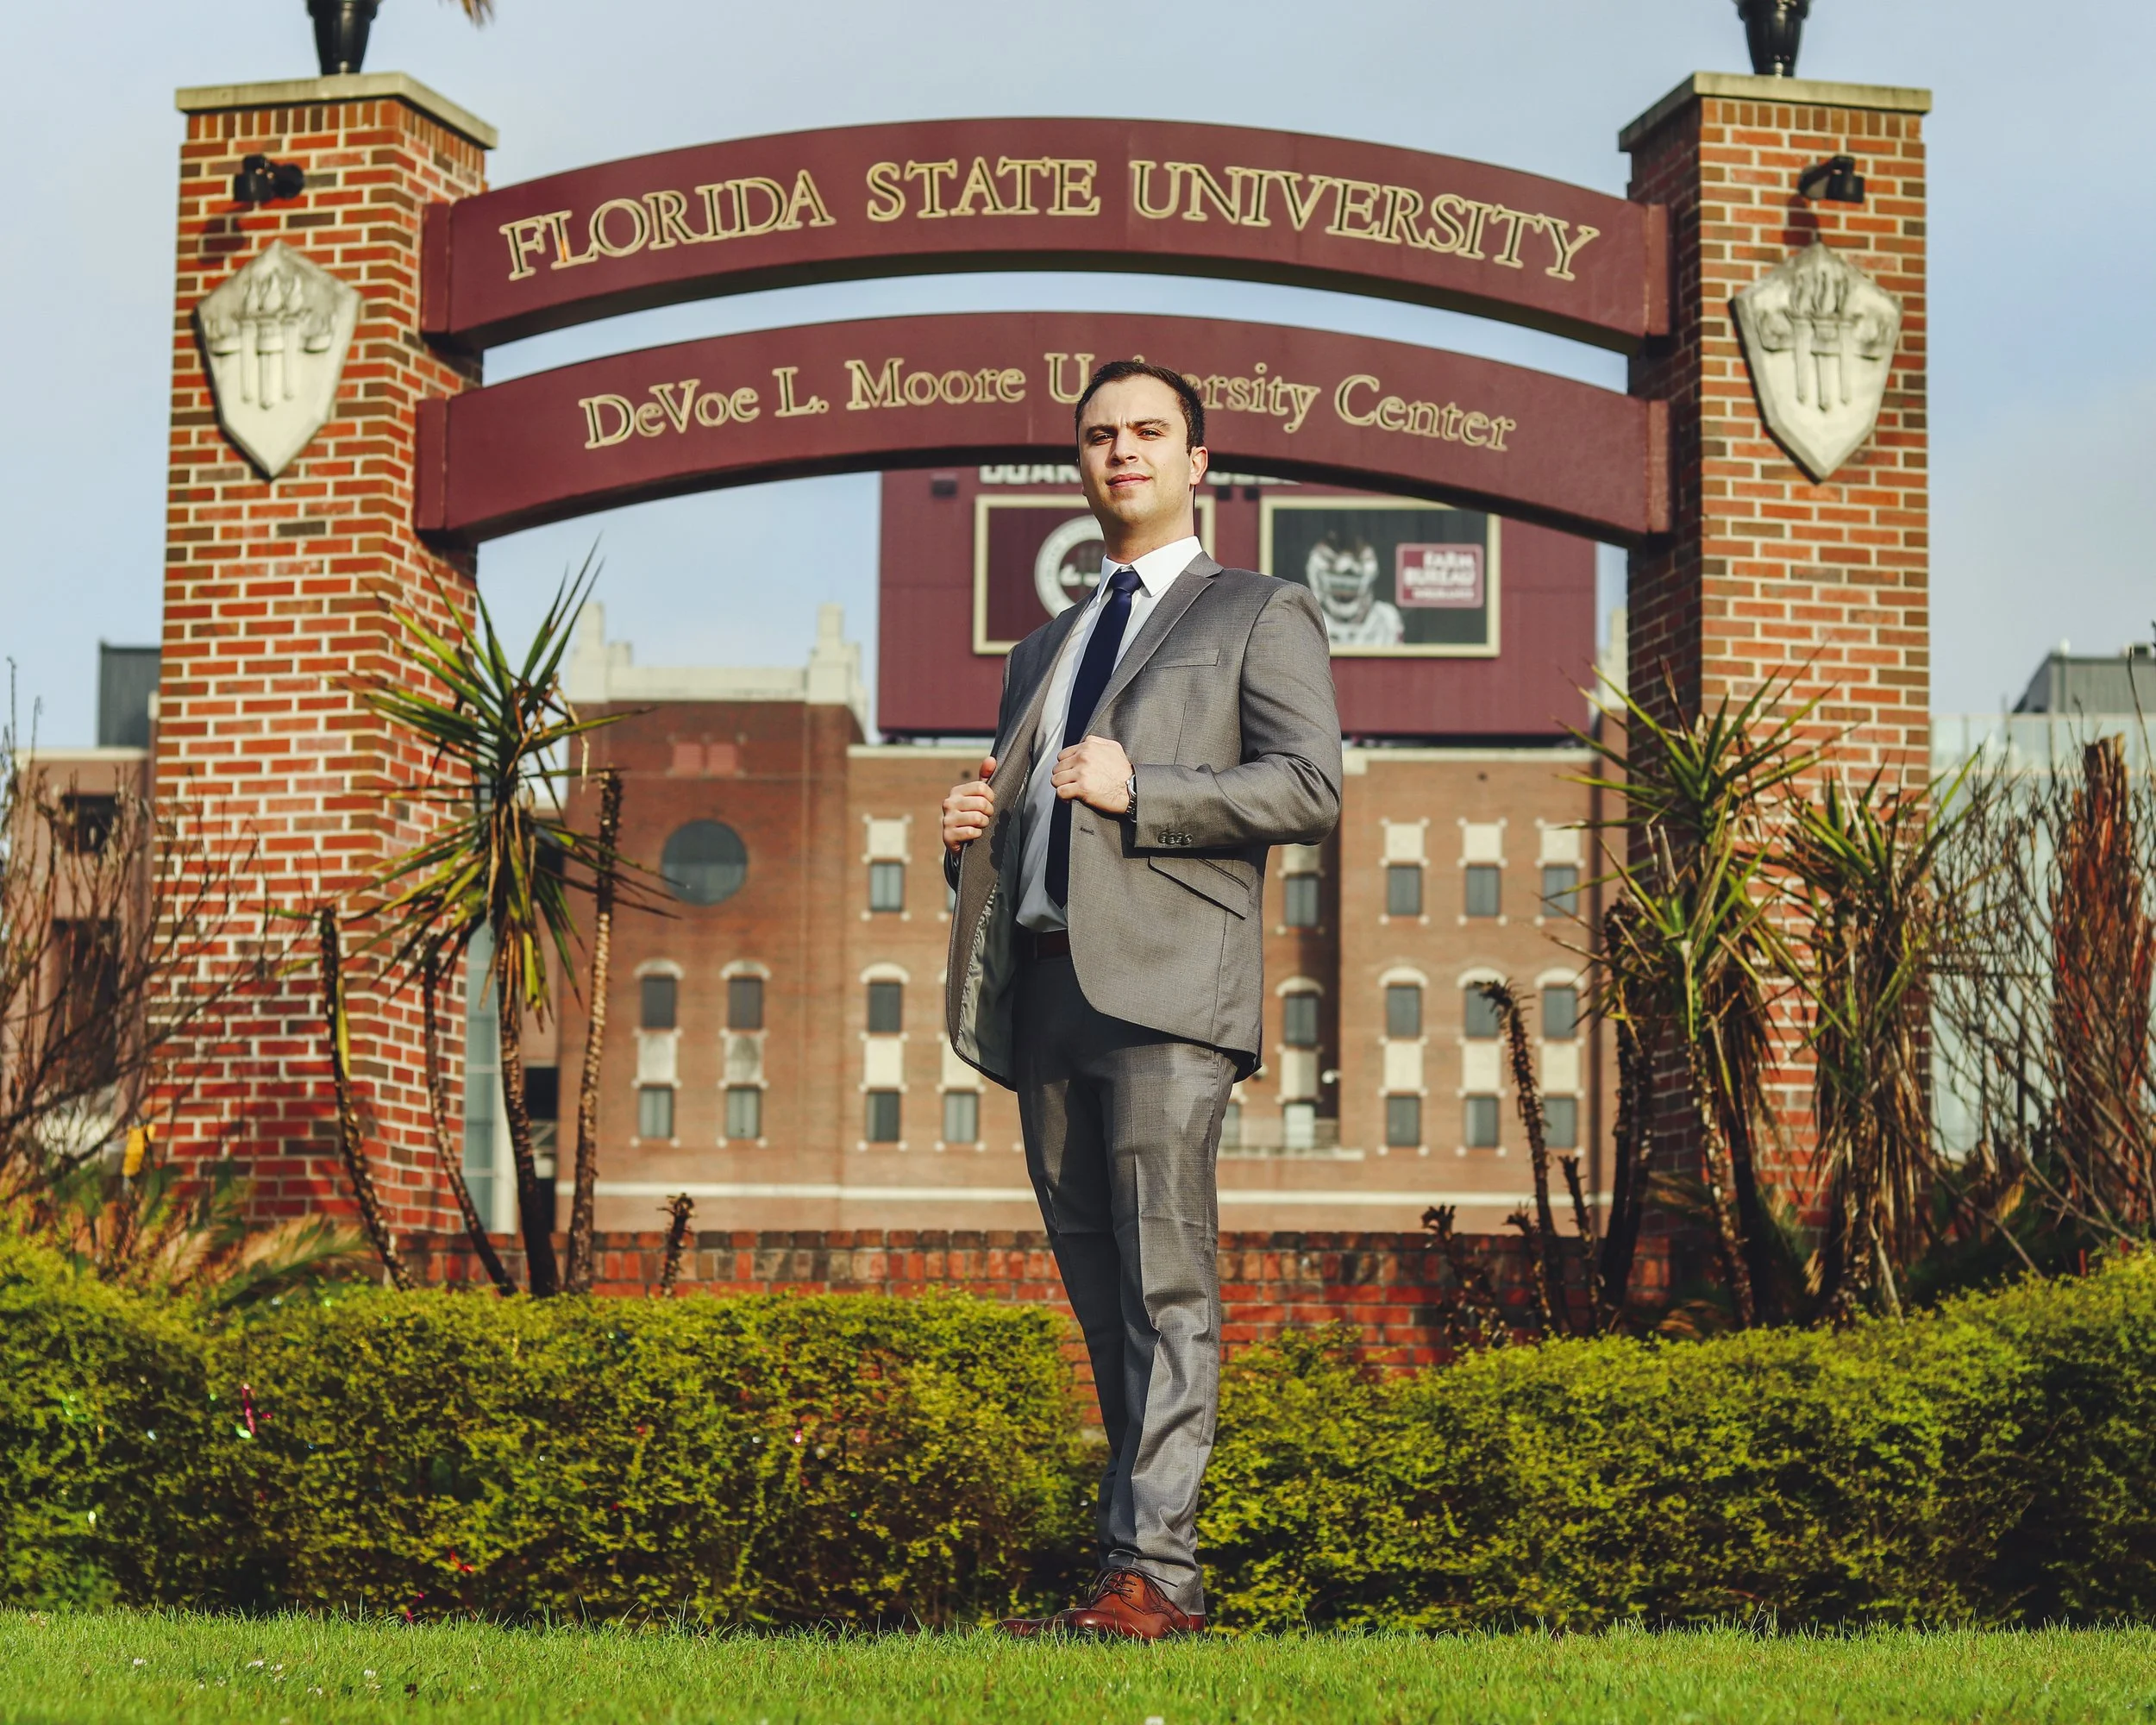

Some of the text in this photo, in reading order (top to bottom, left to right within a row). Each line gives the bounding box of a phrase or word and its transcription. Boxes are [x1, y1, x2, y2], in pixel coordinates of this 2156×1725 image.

[500, 156, 1600, 281] FLORIDA STATE UNIVERSITY
[579, 352, 1516, 451] DeVoe L. Moore Ursity Center
